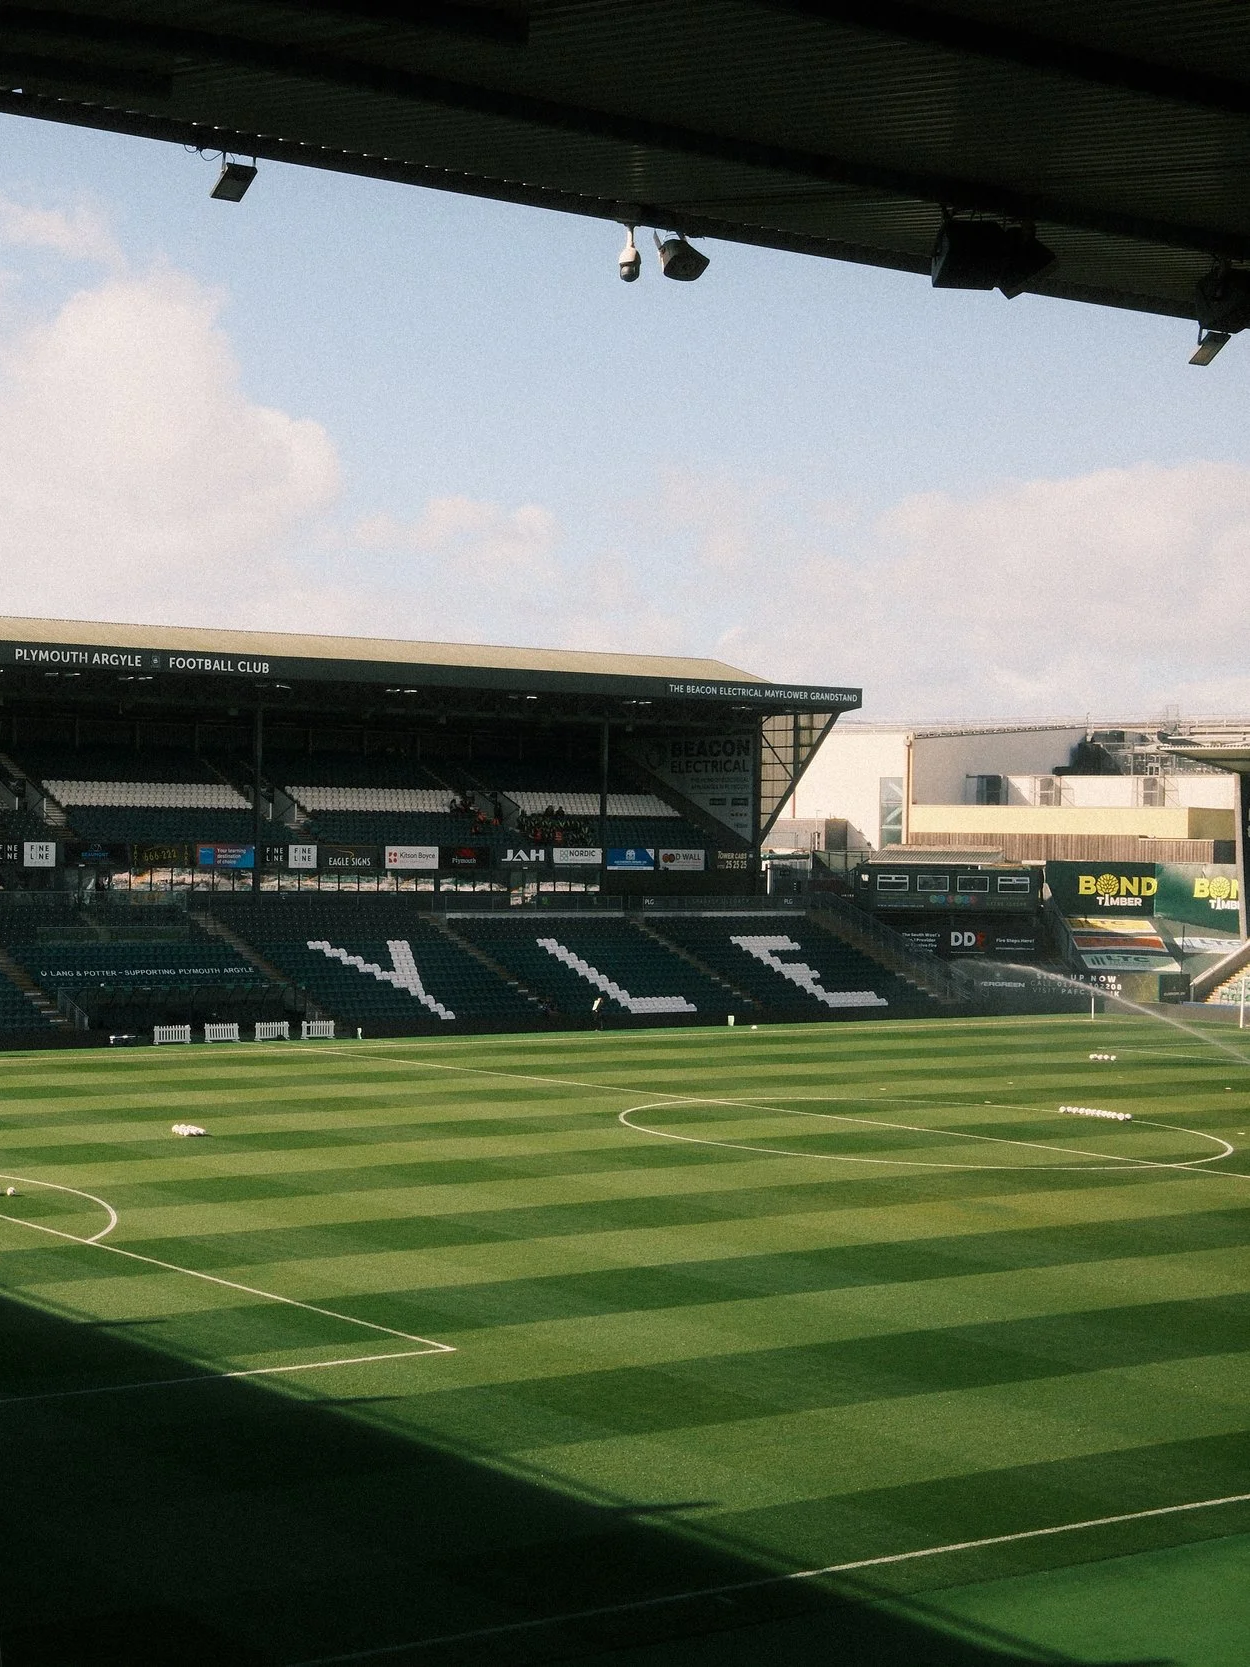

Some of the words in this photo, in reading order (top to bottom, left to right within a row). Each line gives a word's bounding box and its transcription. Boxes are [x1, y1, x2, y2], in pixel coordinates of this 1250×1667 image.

[14, 648, 88, 664] PLYMOUTH
[92, 652, 142, 667] ARGYLE
[169, 657, 234, 672] FOOTBALL
[237, 660, 270, 674] CLUB
[669, 684, 684, 693] THE
[686, 685, 717, 695] BEACON
[719, 686, 763, 697] ELECTRICAL
[764, 689, 808, 700] MAYFLOWER
[809, 691, 858, 702] GRANDSTAND
[670, 739, 750, 757] BEACON
[670, 759, 750, 774] ELECTRICAL
[328, 857, 349, 866] EAGLE
[351, 857, 371, 866] SIGNS
[418, 852, 436, 860] Boyce
[501, 849, 545, 862] JAH
[683, 853, 701, 861] WALL
[725, 860, 732, 869] 25
[733, 860, 740, 869] 25
[740, 860, 748, 869] 25
[1077, 873, 1158, 897] BOND
[1096, 894, 1142, 907] TIMBER
[1107, 954, 1150, 963] LTC
[222, 966, 255, 974] ARGYLE
[1090, 975, 1117, 983] NOW
